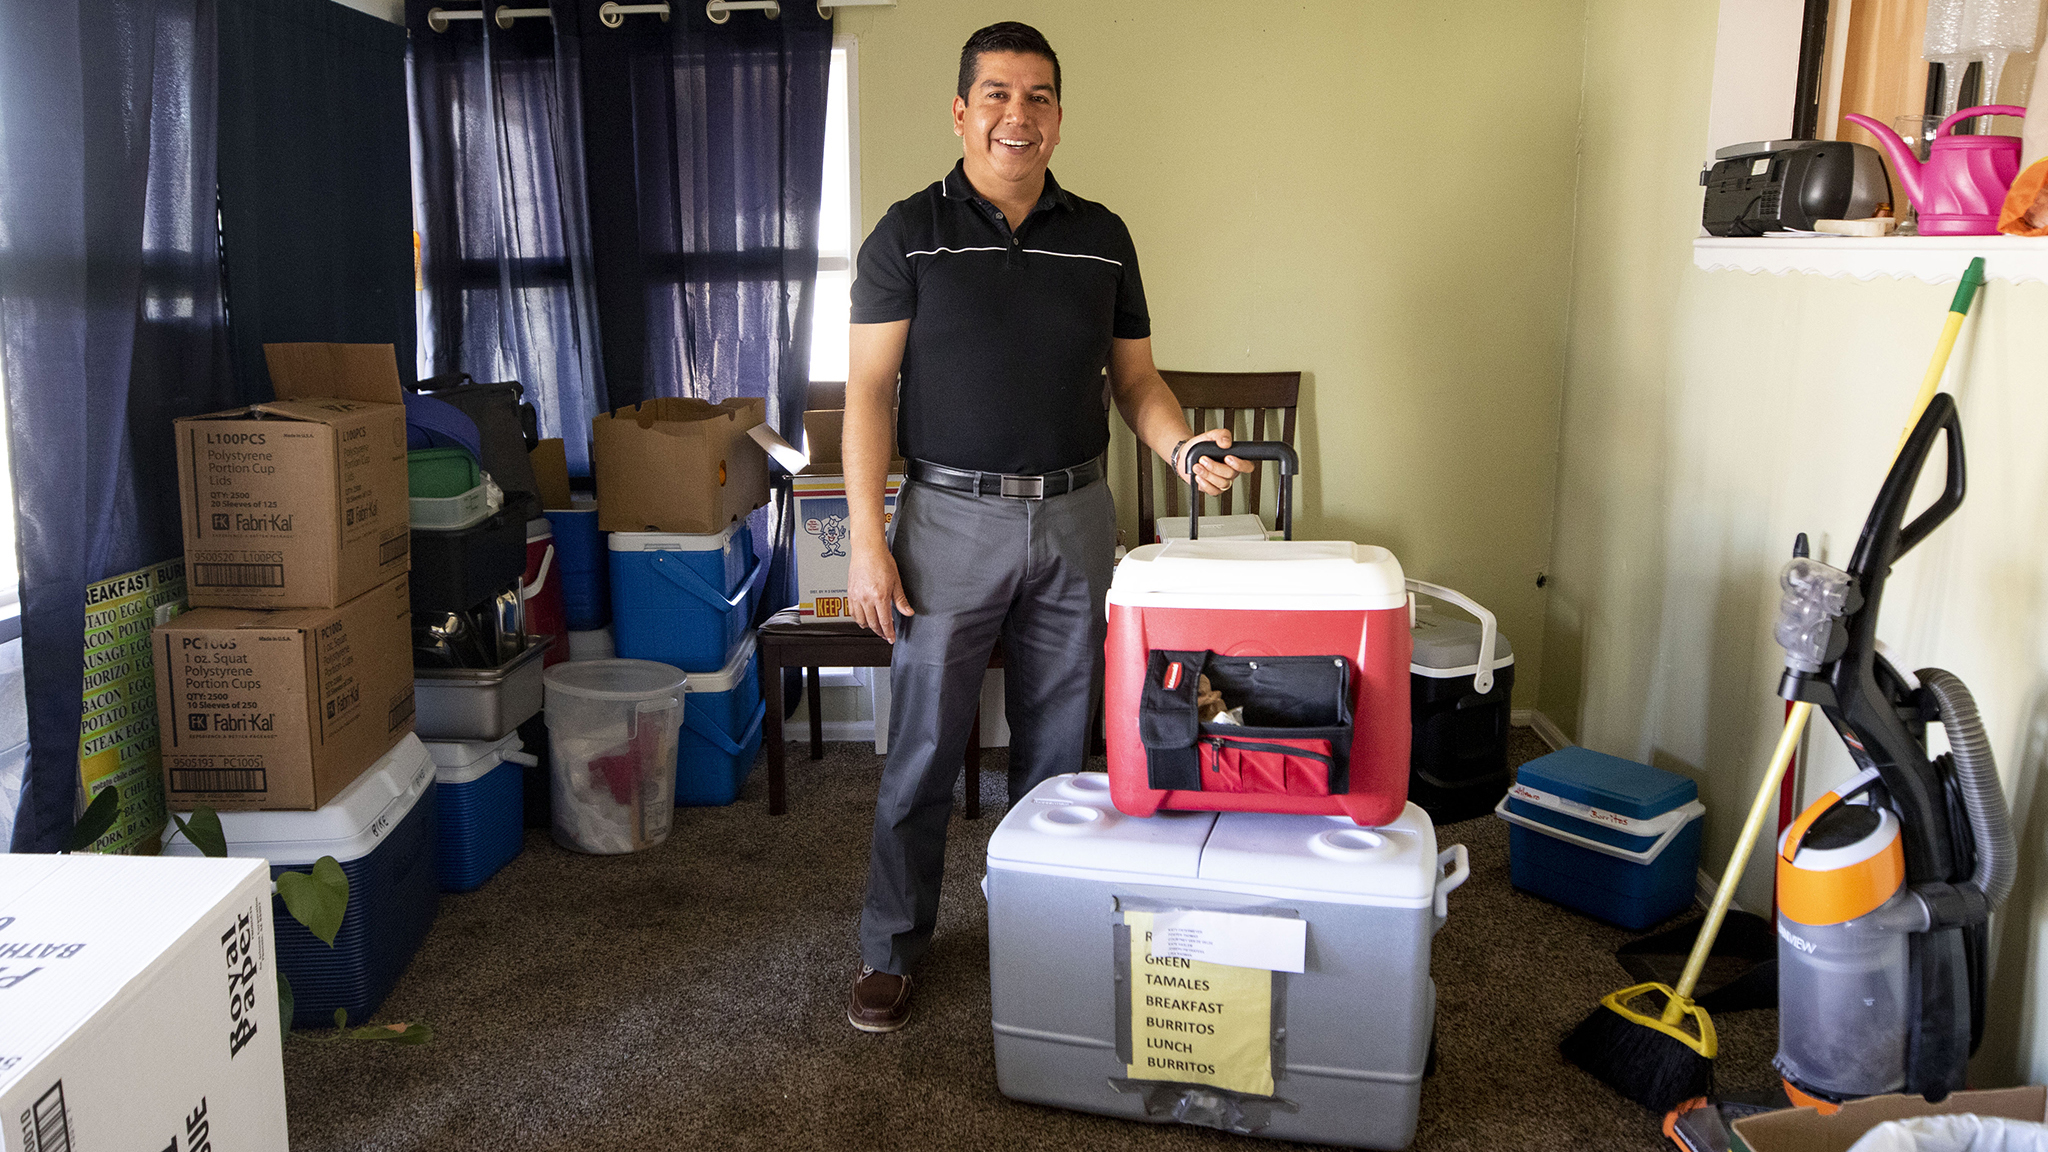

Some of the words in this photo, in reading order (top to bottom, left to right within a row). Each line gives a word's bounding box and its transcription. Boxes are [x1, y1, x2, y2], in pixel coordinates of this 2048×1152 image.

[207, 433, 266, 445] L100PCS
[208, 450, 272, 463] Polystyrene
[208, 463, 250, 474] Portion
[252, 463, 275, 476] Cup
[209, 476, 232, 486] Lids
[230, 491, 250, 499] 2500
[194, 552, 234, 562] 9500520
[243, 552, 283, 563] L100PCS
[85, 573, 150, 606] REAKFAST
[157, 563, 185, 584] BUR
[86, 610, 117, 629] TATO
[120, 600, 142, 619] EGG
[816, 597, 842, 618] KEEP
[84, 629, 114, 650] ACON
[83, 643, 127, 670] AUSAGE
[130, 635, 152, 655] EGG
[185, 653, 190, 663] 1
[194, 655, 211, 664] oz.
[214, 653, 248, 665] Squat
[84, 662, 130, 690] HORIZO
[185, 665, 253, 677] Polystyrene
[186, 678, 229, 689] Portion
[231, 678, 261, 691] Cups
[82, 688, 121, 715] BACON
[128, 676, 151, 695] EGG
[82, 705, 127, 734] POTATO
[131, 695, 153, 714] EGG
[214, 713, 274, 731] Fabri-Kal
[84, 728, 124, 756] STEAK
[126, 717, 149, 739] EGG
[120, 735, 156, 761] LUNCH
[173, 758, 214, 767] 9505193
[223, 758, 261, 767] PC100S
[96, 830, 123, 851] PORK
[1145, 953, 1191, 969] GREEN
[237, 911, 258, 1047] Paper
[1145, 973, 1210, 991] TAMALES
[221, 922, 244, 1061] Royal
[1146, 995, 1224, 1014] BREAKFAST
[1146, 1017, 1215, 1035] BURRITOS
[1147, 1038, 1193, 1054] LUNCH
[1147, 1056, 1216, 1075] BURRITOS
